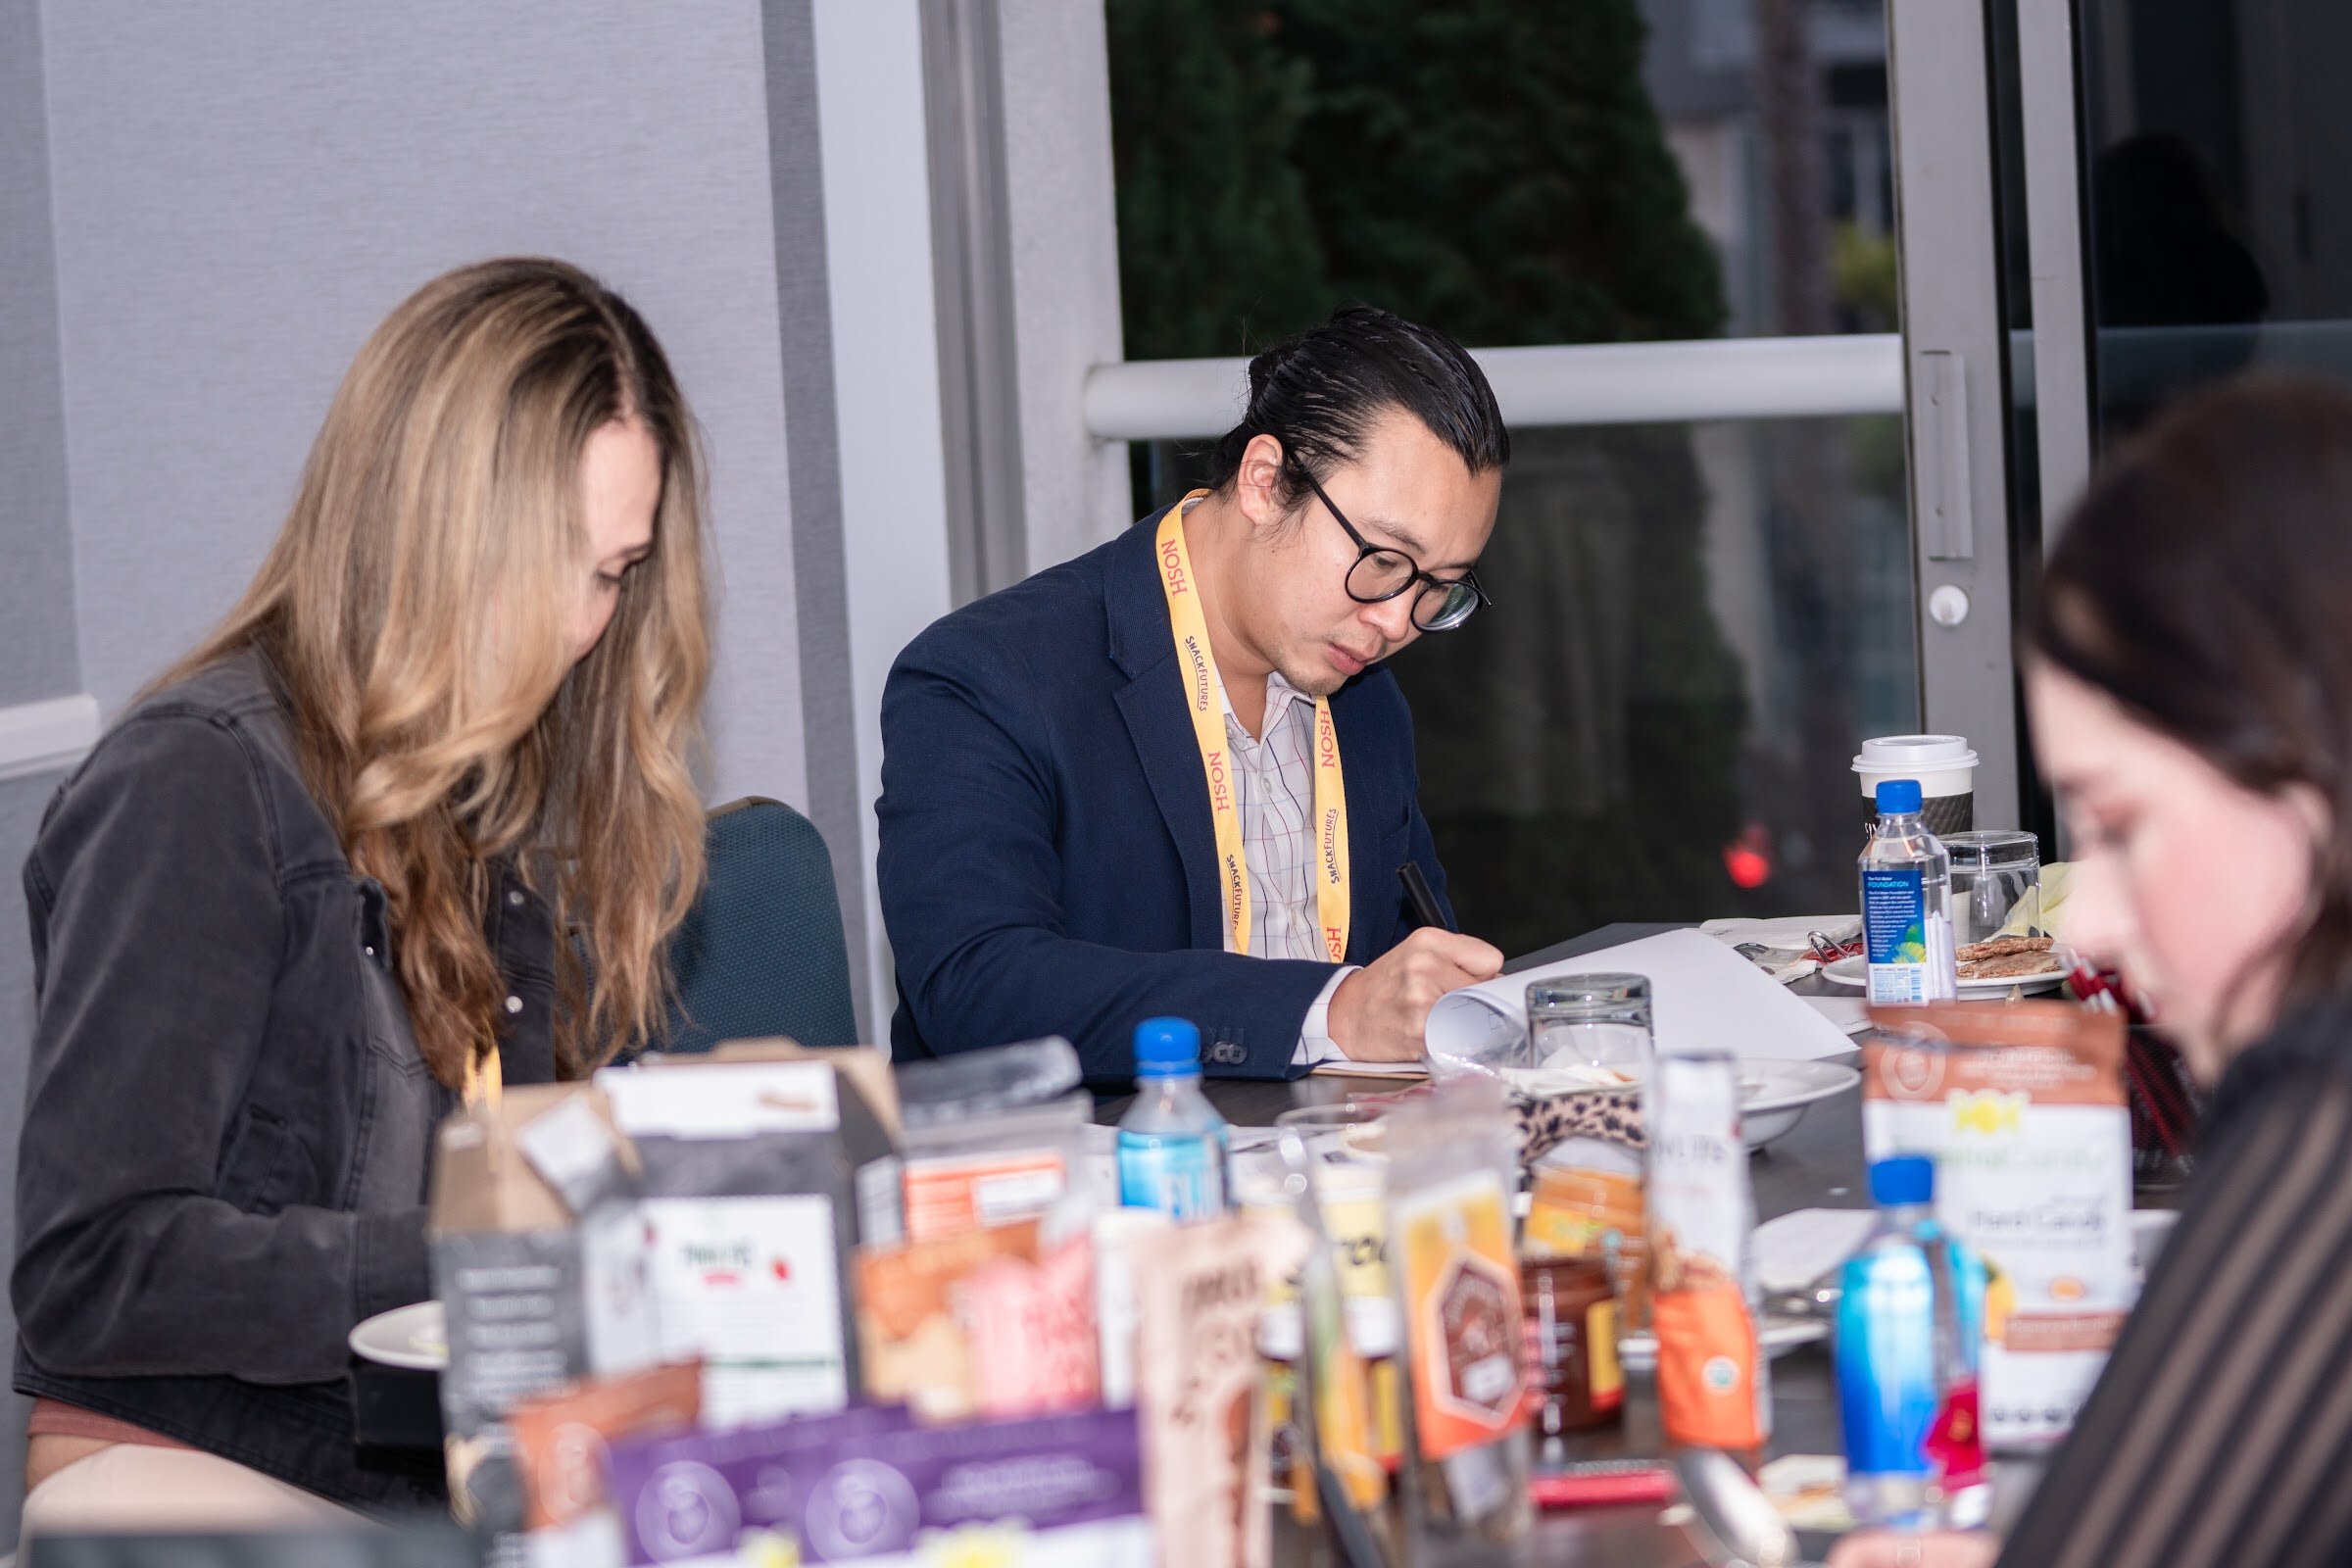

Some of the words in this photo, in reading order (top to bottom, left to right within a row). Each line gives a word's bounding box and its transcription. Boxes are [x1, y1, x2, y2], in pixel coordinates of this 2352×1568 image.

[1161, 539, 1188, 597] NOSH
[1185, 635, 1208, 712] SNACKFUTURES
[1320, 709, 1336, 769] NOSH
[1207, 751, 1230, 812] NOSH
[1323, 808, 1340, 884] SNACKFUTURES
[1226, 854, 1242, 930] SNACKFUTURE
[1326, 925, 1342, 962] SH
